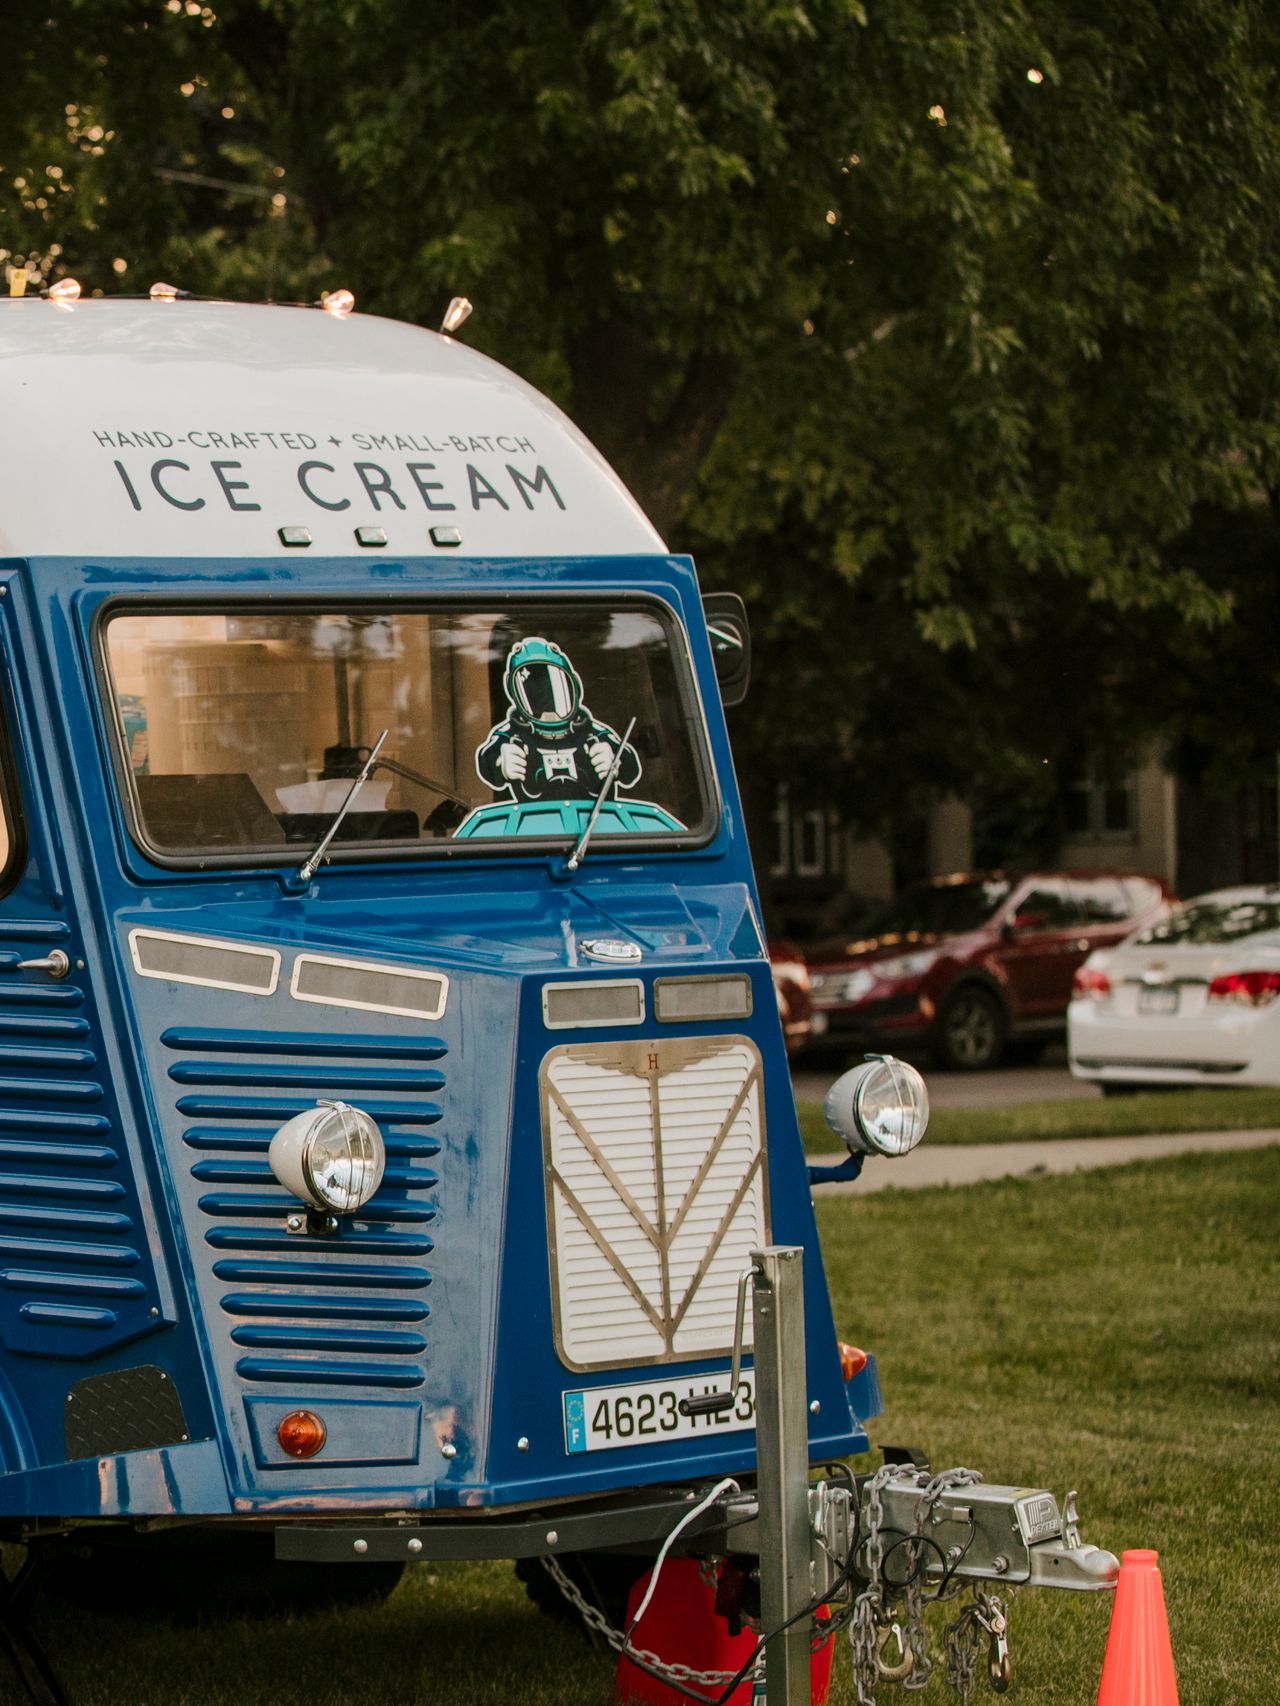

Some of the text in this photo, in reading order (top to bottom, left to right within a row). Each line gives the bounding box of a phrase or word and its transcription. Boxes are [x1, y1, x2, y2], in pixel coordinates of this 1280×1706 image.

[93, 430, 536, 454] HAND-CRAFTED SMALL-BATCH
[113, 459, 566, 511] ICE CREAM
[647, 1053, 659, 1070] H
[571, 1428, 579, 1444] F
[592, 1391, 679, 1440] 4623
